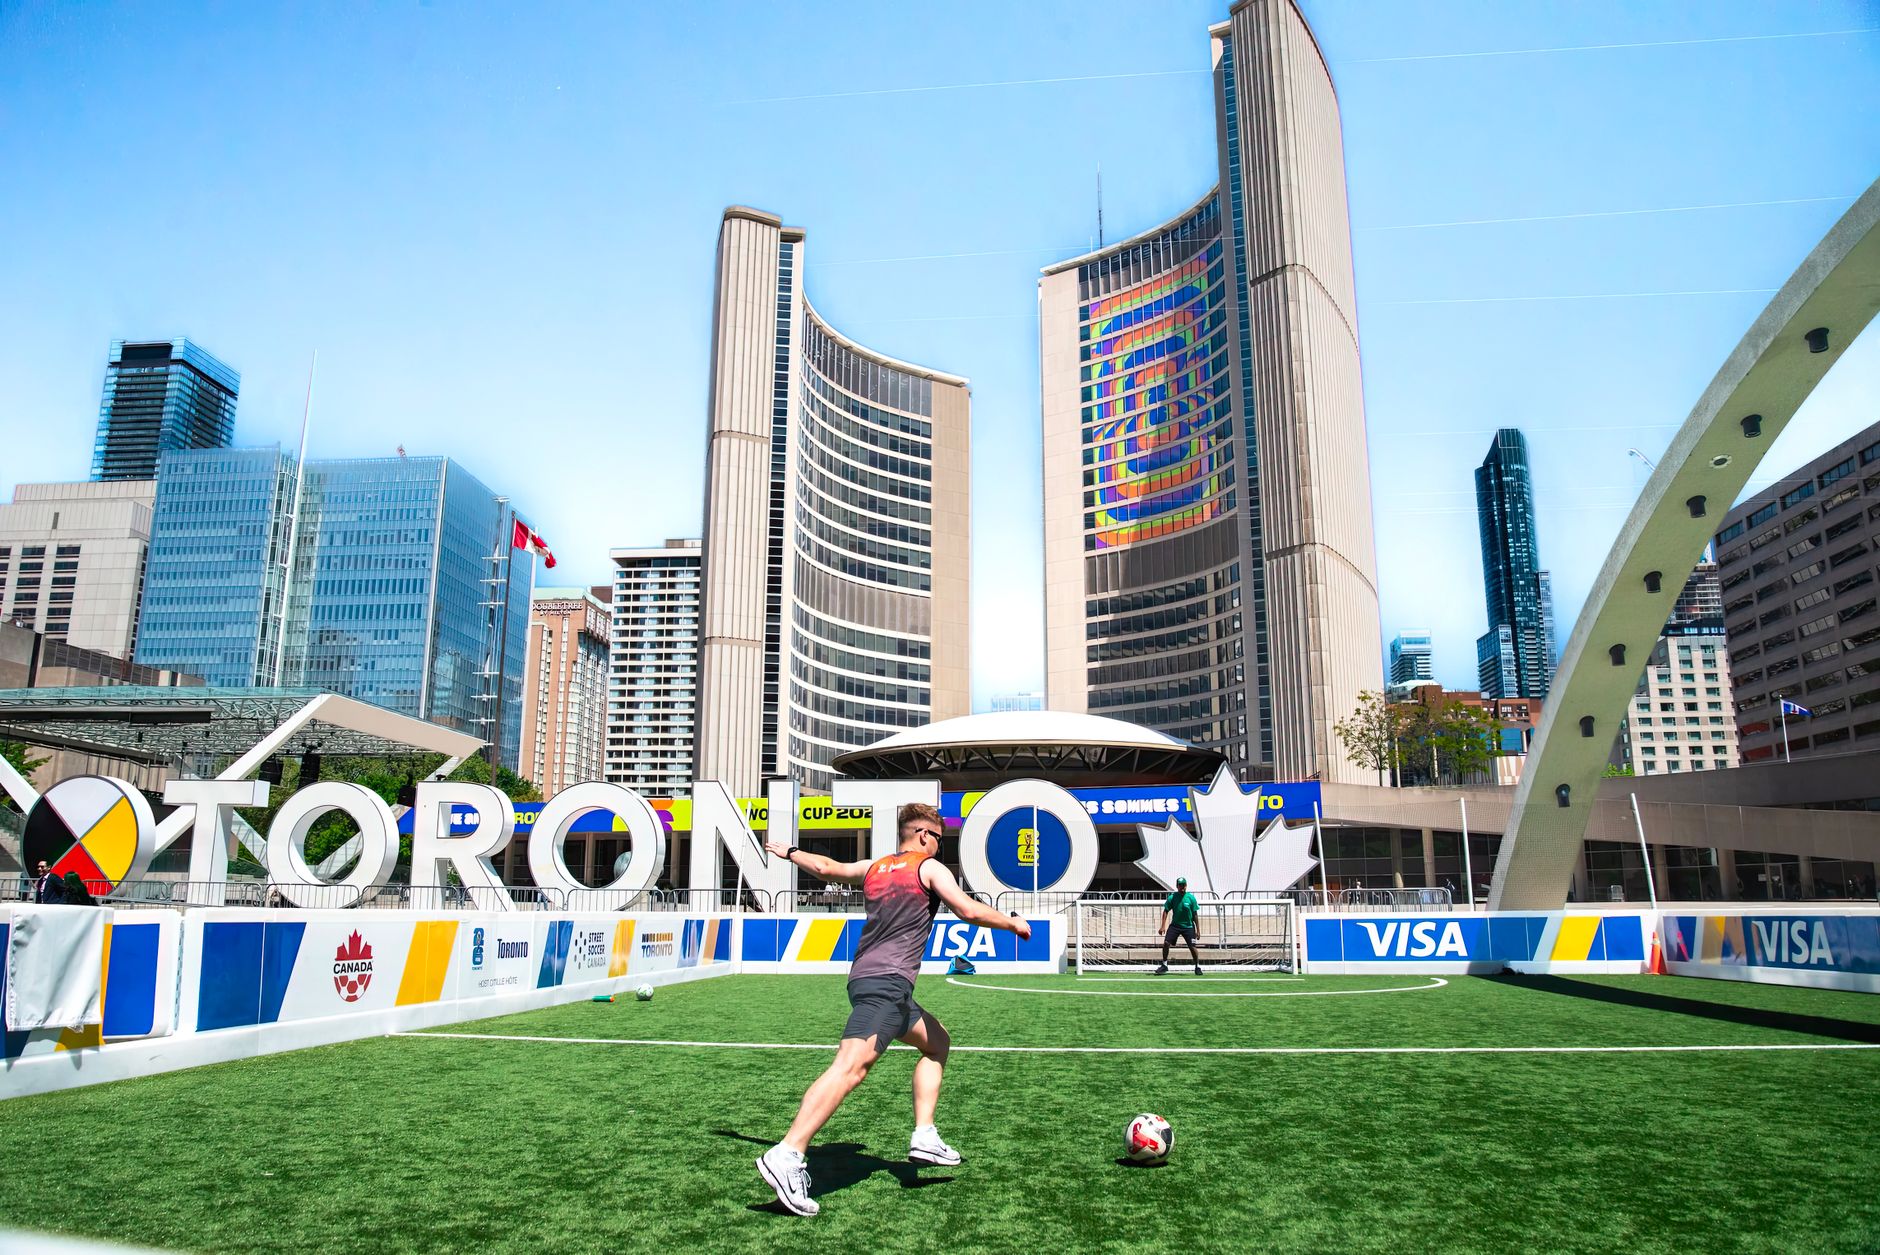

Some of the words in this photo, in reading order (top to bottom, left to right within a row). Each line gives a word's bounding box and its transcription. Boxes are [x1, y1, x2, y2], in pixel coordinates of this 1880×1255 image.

[802, 807, 833, 820] CUP
[835, 808, 872, 819] 202
[1102, 798, 1179, 814] SOMMES
[164, 777, 1100, 911] TORONTO
[588, 932, 605, 943] STREET
[928, 923, 997, 958] ISA
[1356, 921, 1468, 957] VISA
[1751, 920, 1834, 965] VISA
[497, 938, 529, 959] TORONTO
[587, 944, 605, 956] SOCCER
[641, 943, 673, 958] TORONTO
[333, 961, 373, 975] CANADA
[587, 957, 606, 969] CANADA
